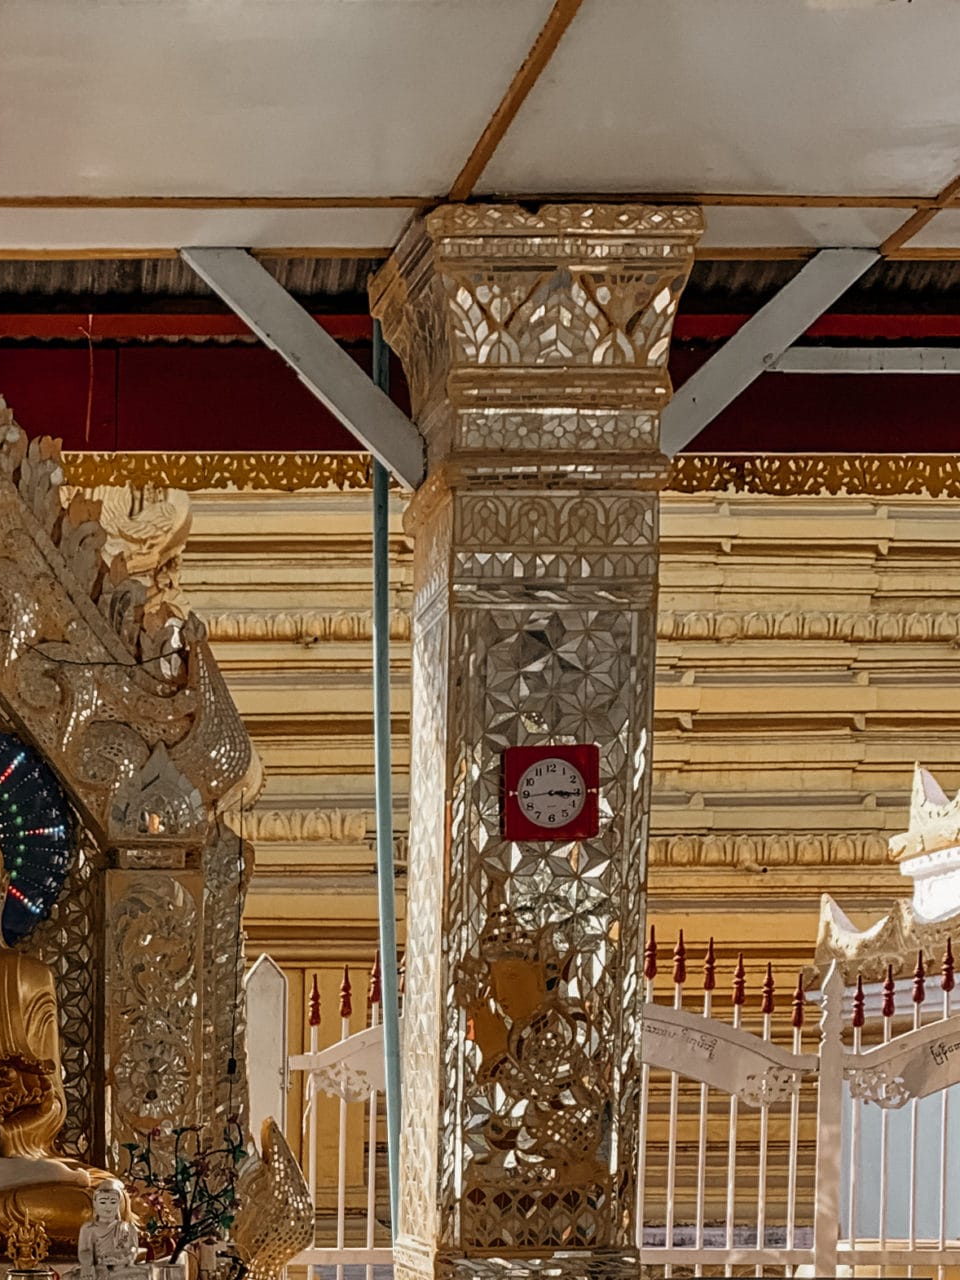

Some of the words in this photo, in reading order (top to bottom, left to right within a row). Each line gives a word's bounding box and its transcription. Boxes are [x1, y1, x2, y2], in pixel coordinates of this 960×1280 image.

[535, 767, 543, 777] 11
[546, 763, 557, 773] 12
[526, 778, 535, 786] 10
[570, 775, 577, 783] 2
[522, 790, 530, 799] 9
[534, 811, 542, 820] 7
[548, 814, 556, 823] 6
[561, 810, 569, 818] 5
